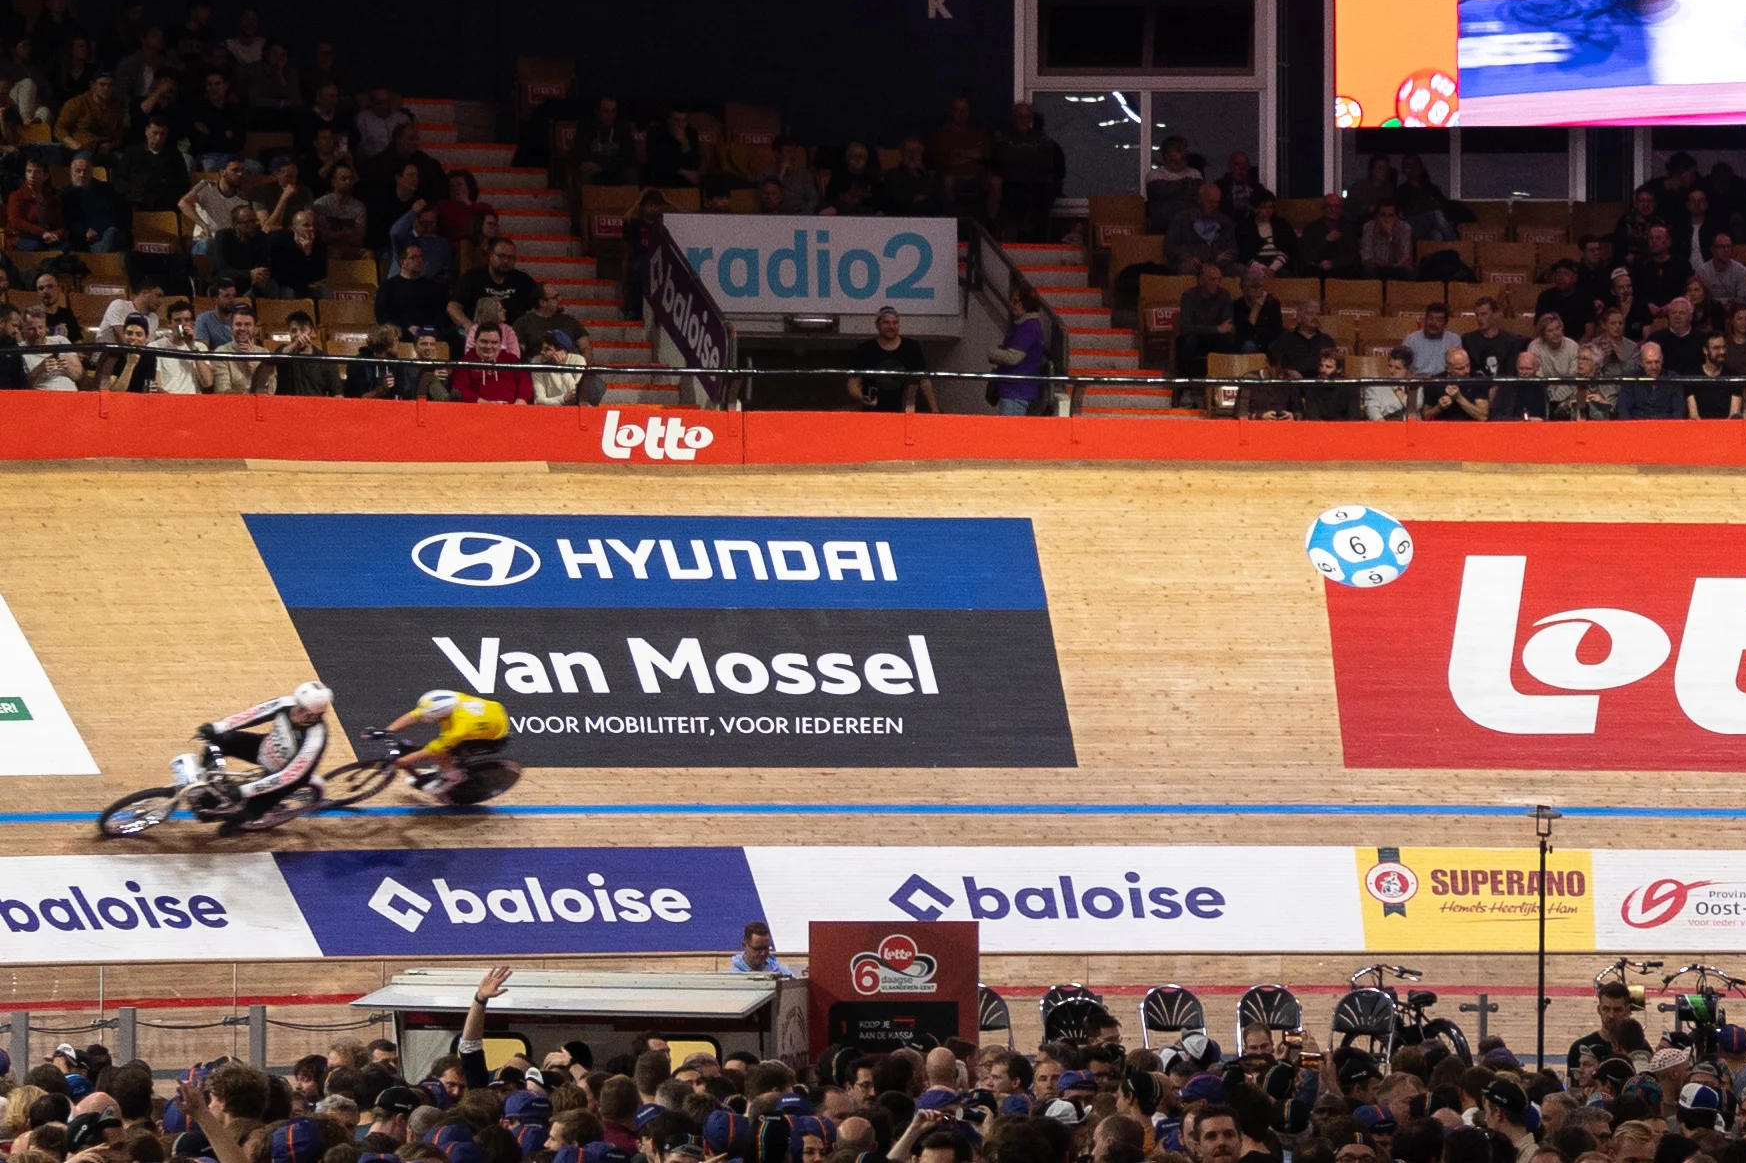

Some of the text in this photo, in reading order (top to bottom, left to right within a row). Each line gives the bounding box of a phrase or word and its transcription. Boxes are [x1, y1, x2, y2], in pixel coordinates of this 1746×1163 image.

[686, 229, 936, 300] radio2
[662, 264, 720, 382] baloise
[602, 409, 714, 461] lotto
[558, 538, 898, 582] HYUNDAI
[432, 635, 940, 695] Van Mossel
[509, 715, 903, 738] VOOR MOBILITEIT, VOOR IEDEREEN
[432, 873, 692, 924] baloise
[962, 872, 1227, 920] baloise
[1430, 869, 1585, 897] SUPERANO
[0, 880, 229, 933] baloise
[1547, 902, 1578, 914] Ham
[1688, 918, 1711, 926] Voor
[883, 947, 912, 960] lotto
[854, 960, 914, 993] 6 daagse
[859, 1020, 881, 1029] KOOP
[882, 1020, 891, 1029] JE
[859, 1031, 875, 1039] AAN
[876, 1031, 887, 1039] DE
